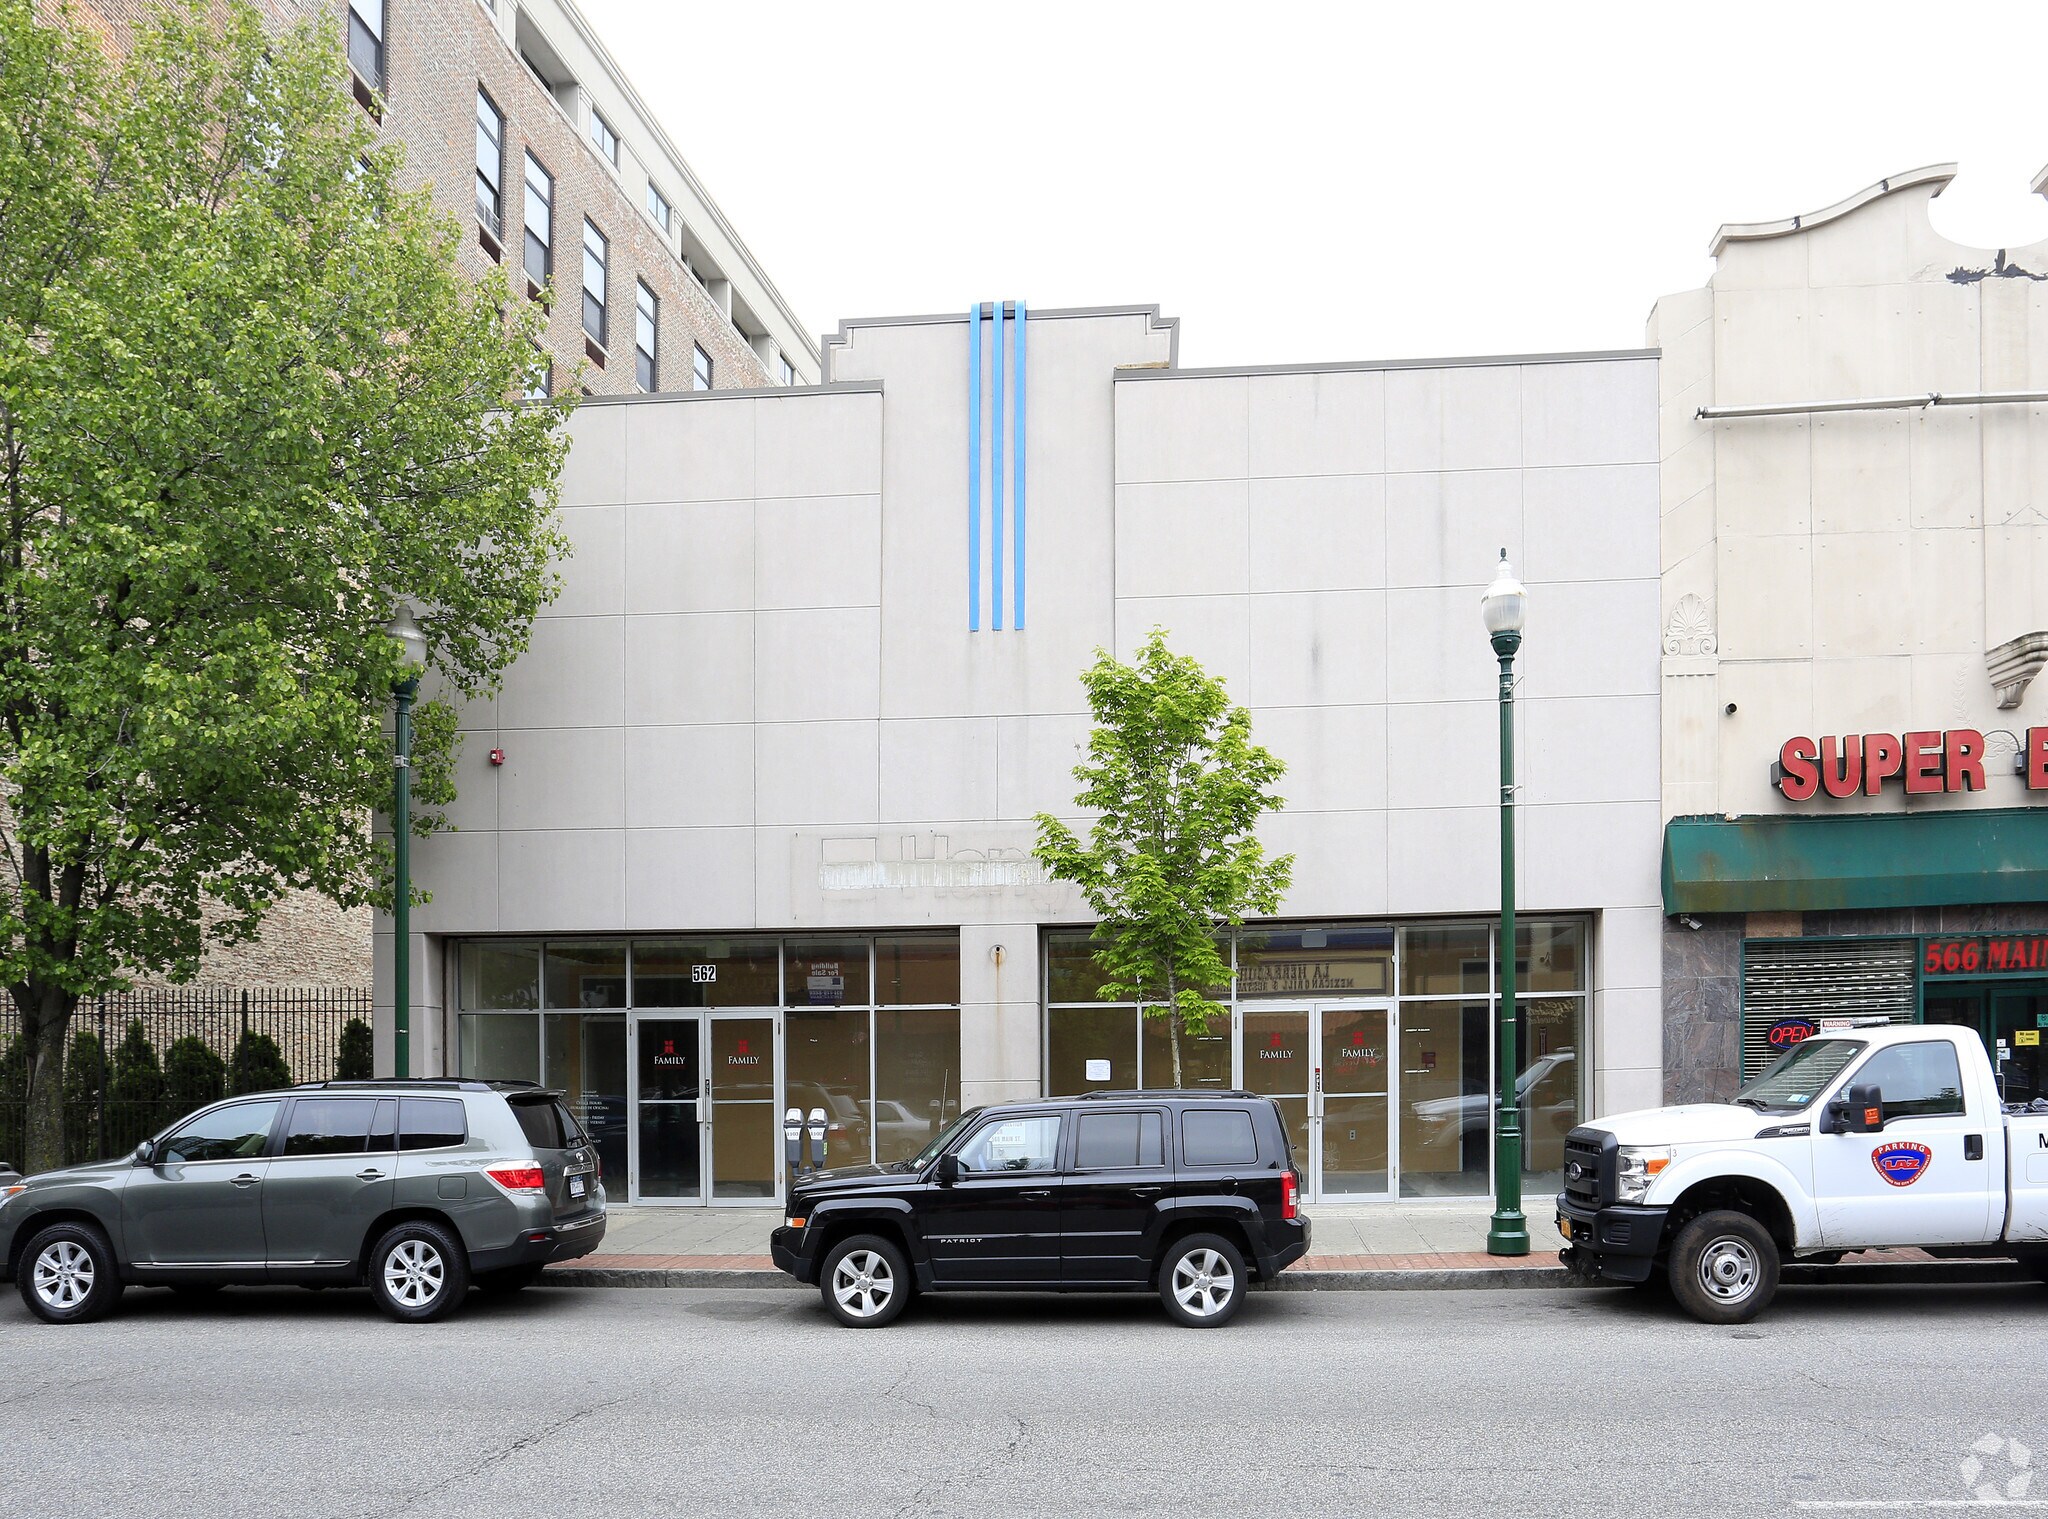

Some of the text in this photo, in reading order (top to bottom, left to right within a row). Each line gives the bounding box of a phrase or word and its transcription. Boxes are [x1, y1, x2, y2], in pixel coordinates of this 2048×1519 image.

[1780, 728, 1986, 801] SUPER
[1924, 942, 1979, 973] 566
[692, 965, 716, 981] 562
[1823, 1020, 1851, 1028] WARNING
[1769, 1026, 1814, 1044] OPEN
[1260, 1050, 1293, 1059] FAMILY
[1342, 1048, 1376, 1058] FAMILY
[654, 1056, 685, 1065] FAMILY
[728, 1056, 760, 1065] FAMILY
[1877, 1142, 1925, 1154] PARKING
[1885, 1159, 1920, 1170] LAZ
